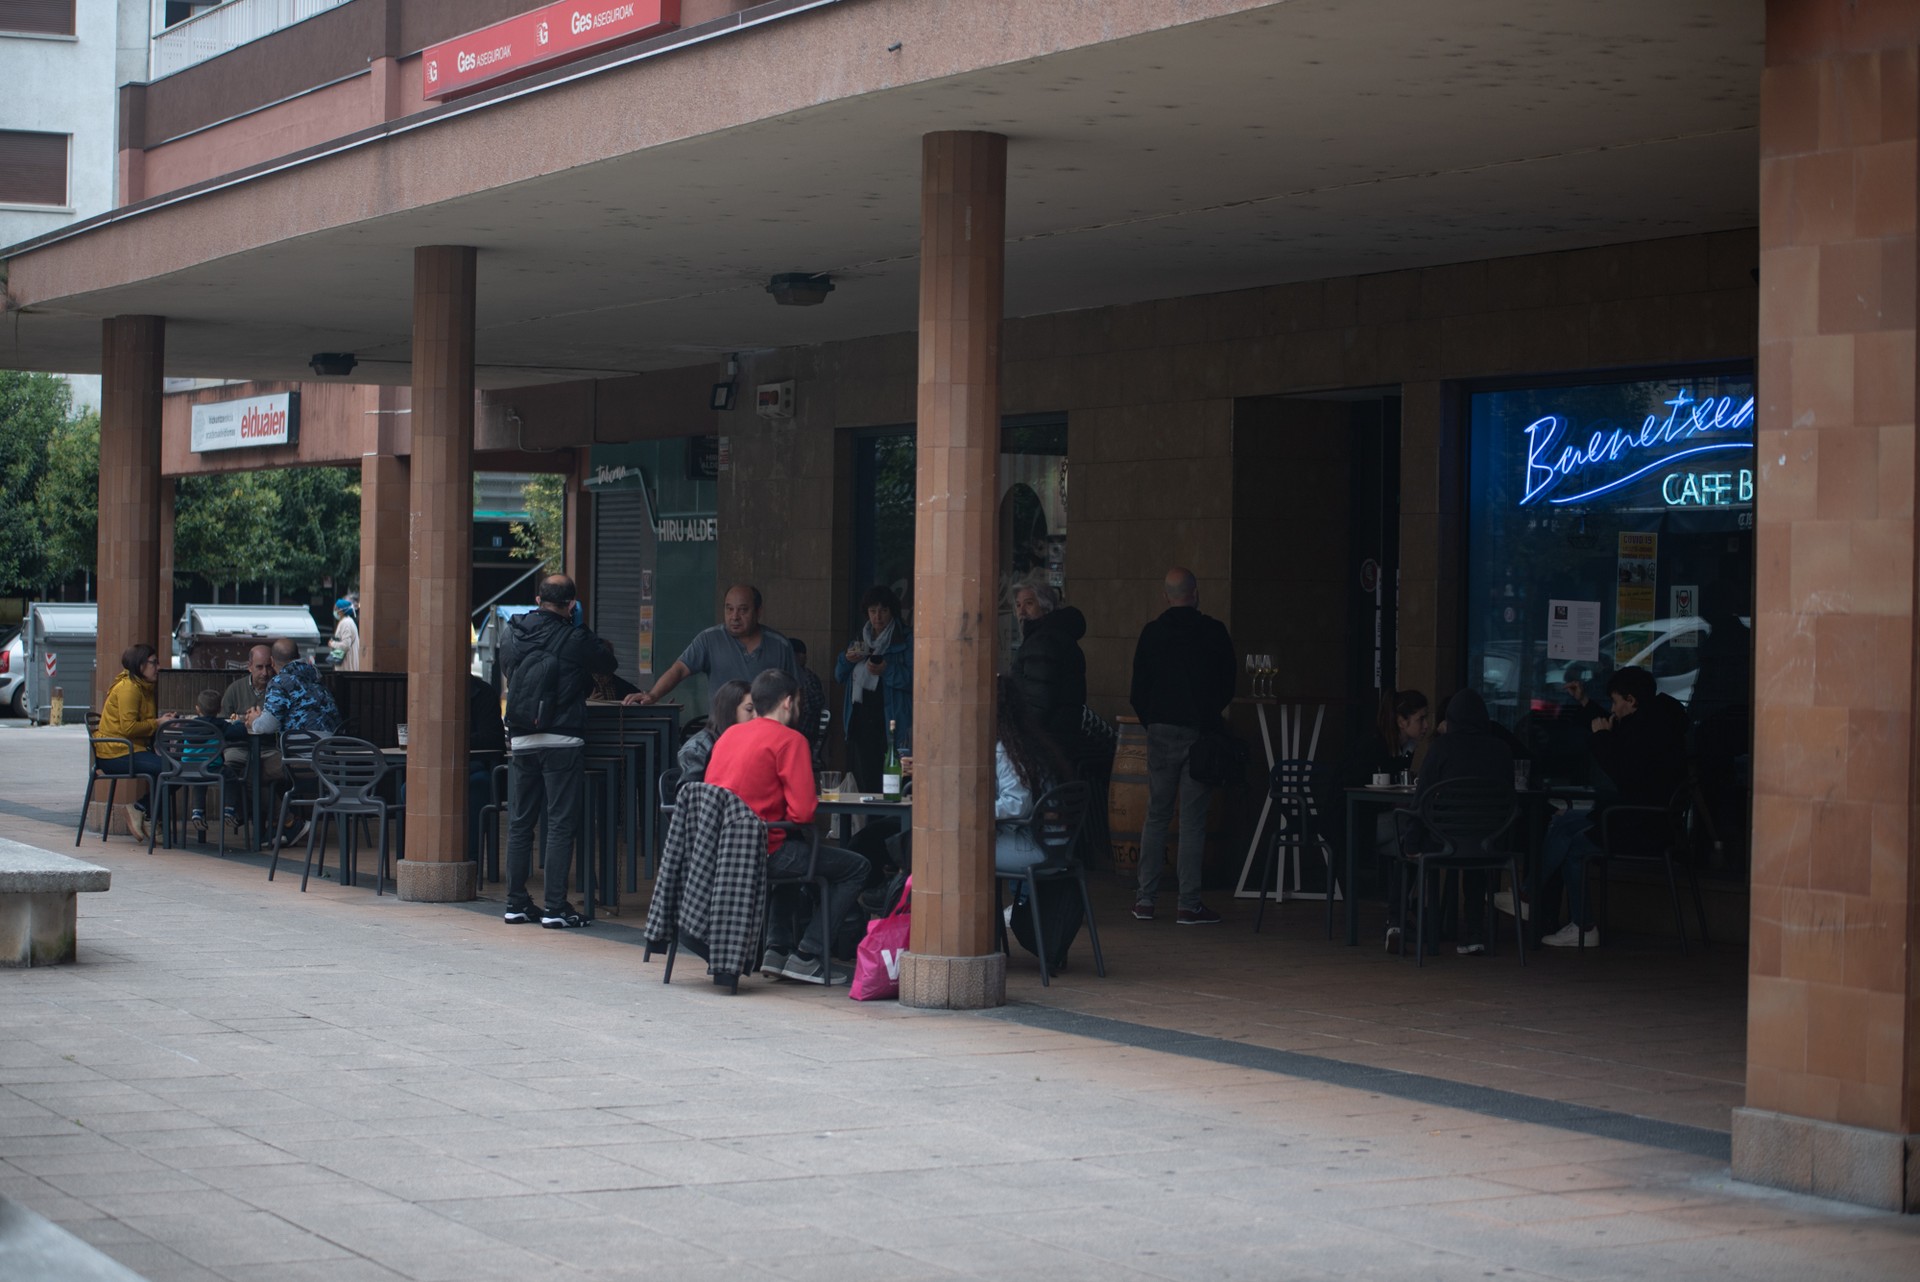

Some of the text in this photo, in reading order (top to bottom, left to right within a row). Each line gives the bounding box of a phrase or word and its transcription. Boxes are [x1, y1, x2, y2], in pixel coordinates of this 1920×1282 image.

[457, 51, 476, 73] Ges
[476, 45, 512, 68] ASEGUROAK
[571, 11, 592, 35] Ges
[592, 3, 634, 29] ASEGUROAK
[241, 403, 286, 438] elduaien
[1662, 473, 1731, 505] CAFE
[658, 519, 684, 542] HIRU
[1113, 846, 1141, 864] TE-O
